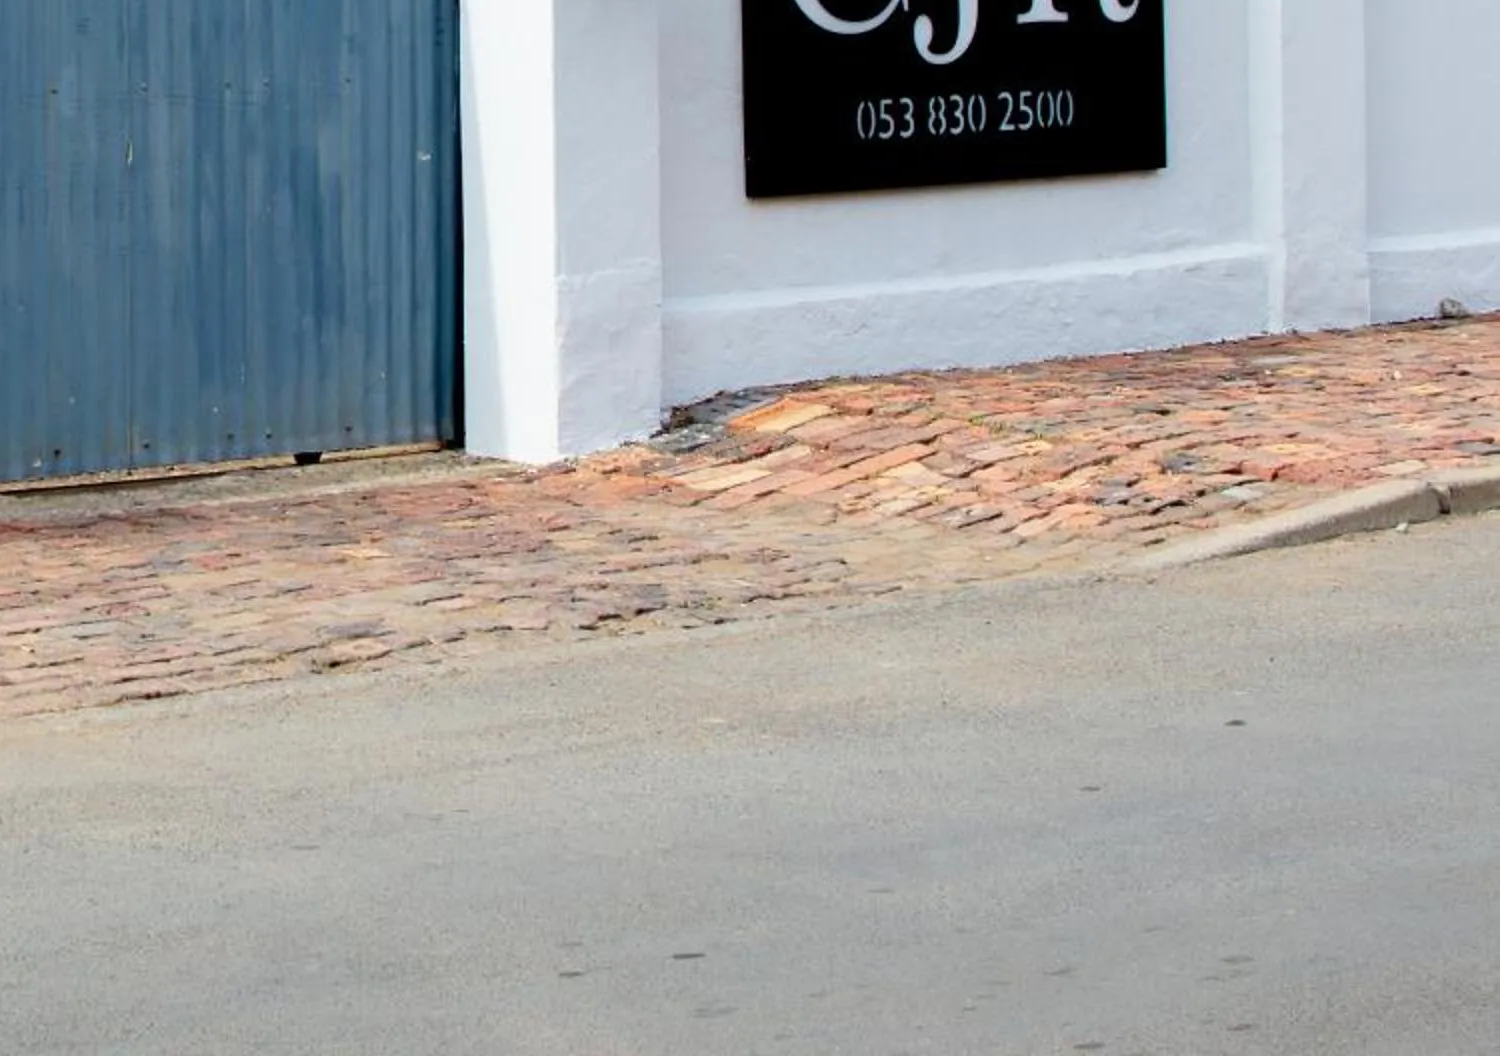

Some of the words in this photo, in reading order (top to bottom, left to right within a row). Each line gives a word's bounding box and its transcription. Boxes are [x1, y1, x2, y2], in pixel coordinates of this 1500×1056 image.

[857, 97, 915, 139] 053
[928, 94, 987, 135] 830
[997, 90, 1074, 131] 2500
